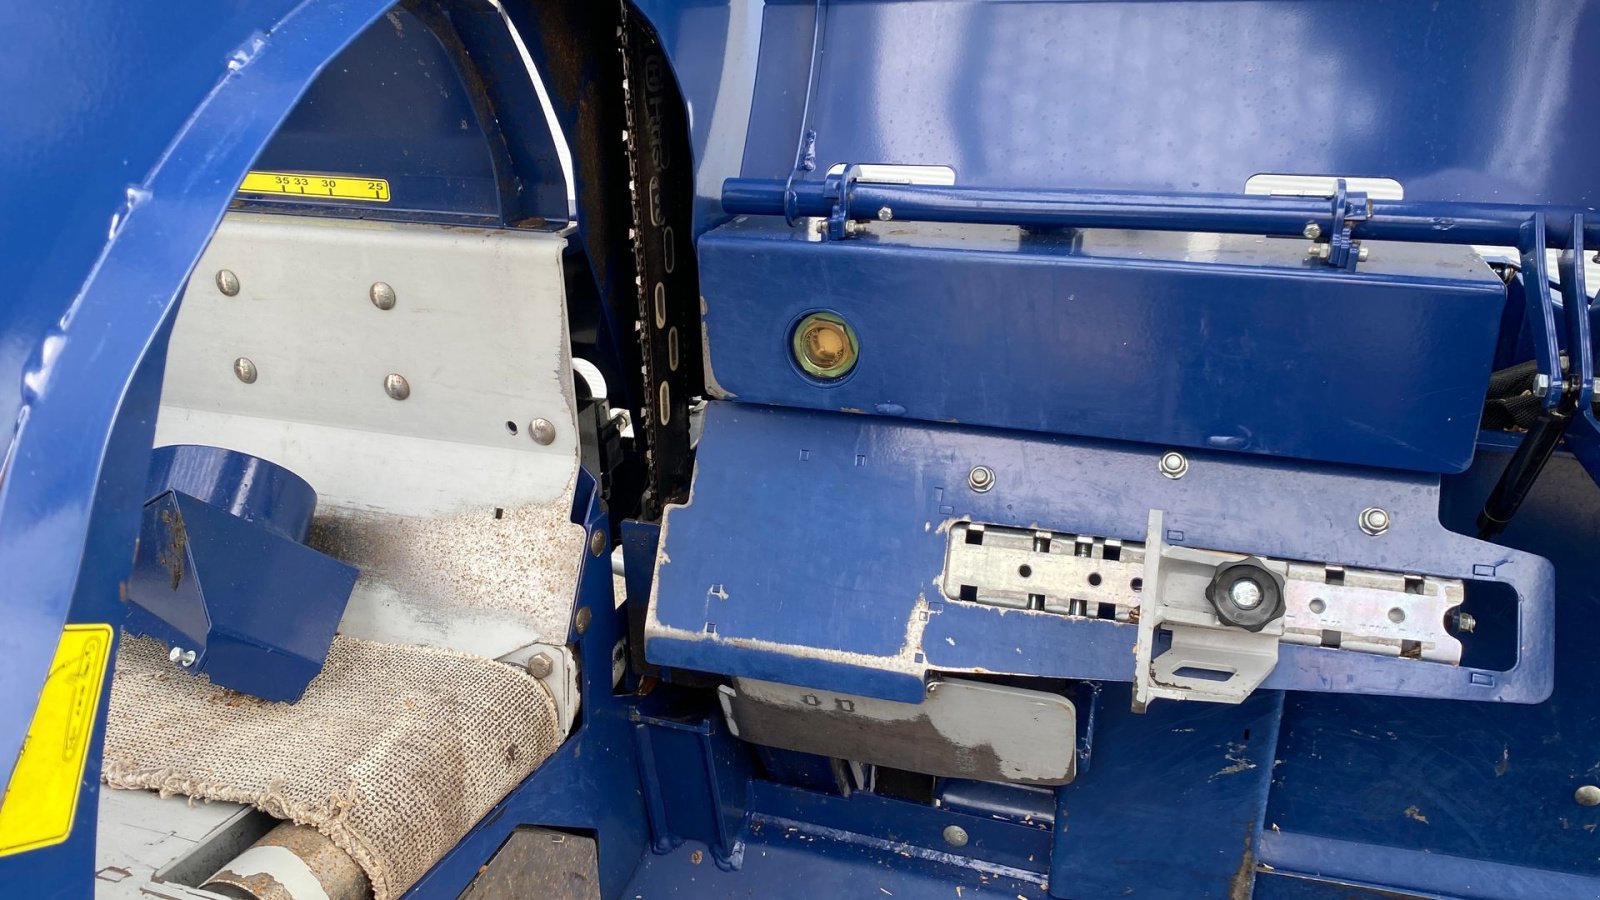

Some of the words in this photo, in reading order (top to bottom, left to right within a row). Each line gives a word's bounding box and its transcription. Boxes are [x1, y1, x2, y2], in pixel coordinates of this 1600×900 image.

[275, 176, 290, 185] 35
[294, 177, 309, 186] 33
[321, 179, 336, 188] 30
[368, 182, 383, 191] 25
